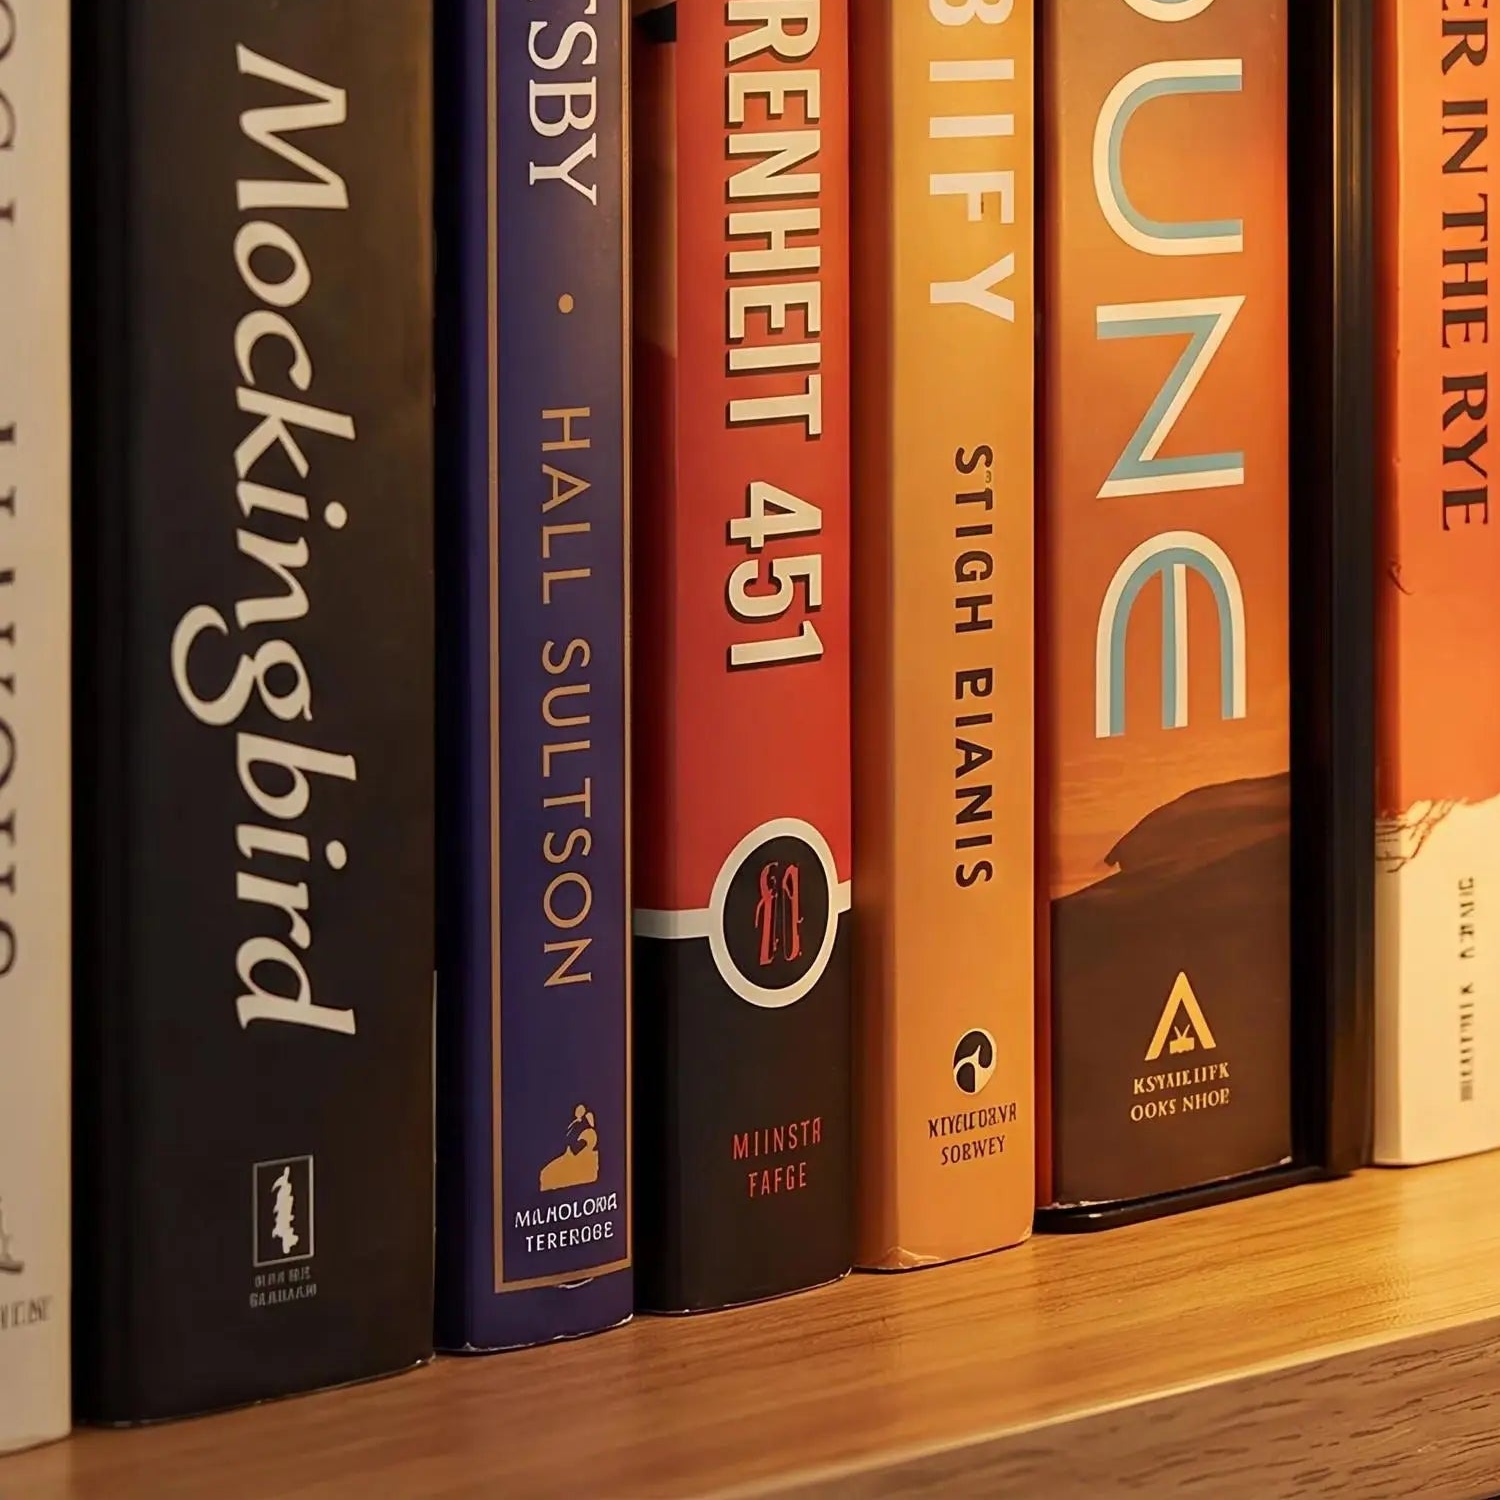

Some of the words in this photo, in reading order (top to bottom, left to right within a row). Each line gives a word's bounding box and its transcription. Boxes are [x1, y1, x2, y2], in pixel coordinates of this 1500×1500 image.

[1442, 99, 1488, 174] IN
[1442, 193, 1488, 348] THE
[543, 407, 591, 604] HALL
[1443, 372, 1488, 531] RYE
[172, 45, 356, 1034] Mockingbird
[725, 482, 823, 672] 451
[955, 445, 993, 633] STIGH
[542, 639, 592, 986] SULTSON
[749, 1162, 806, 1197] FAFGE
[1131, 1099, 1177, 1122] OOKS
